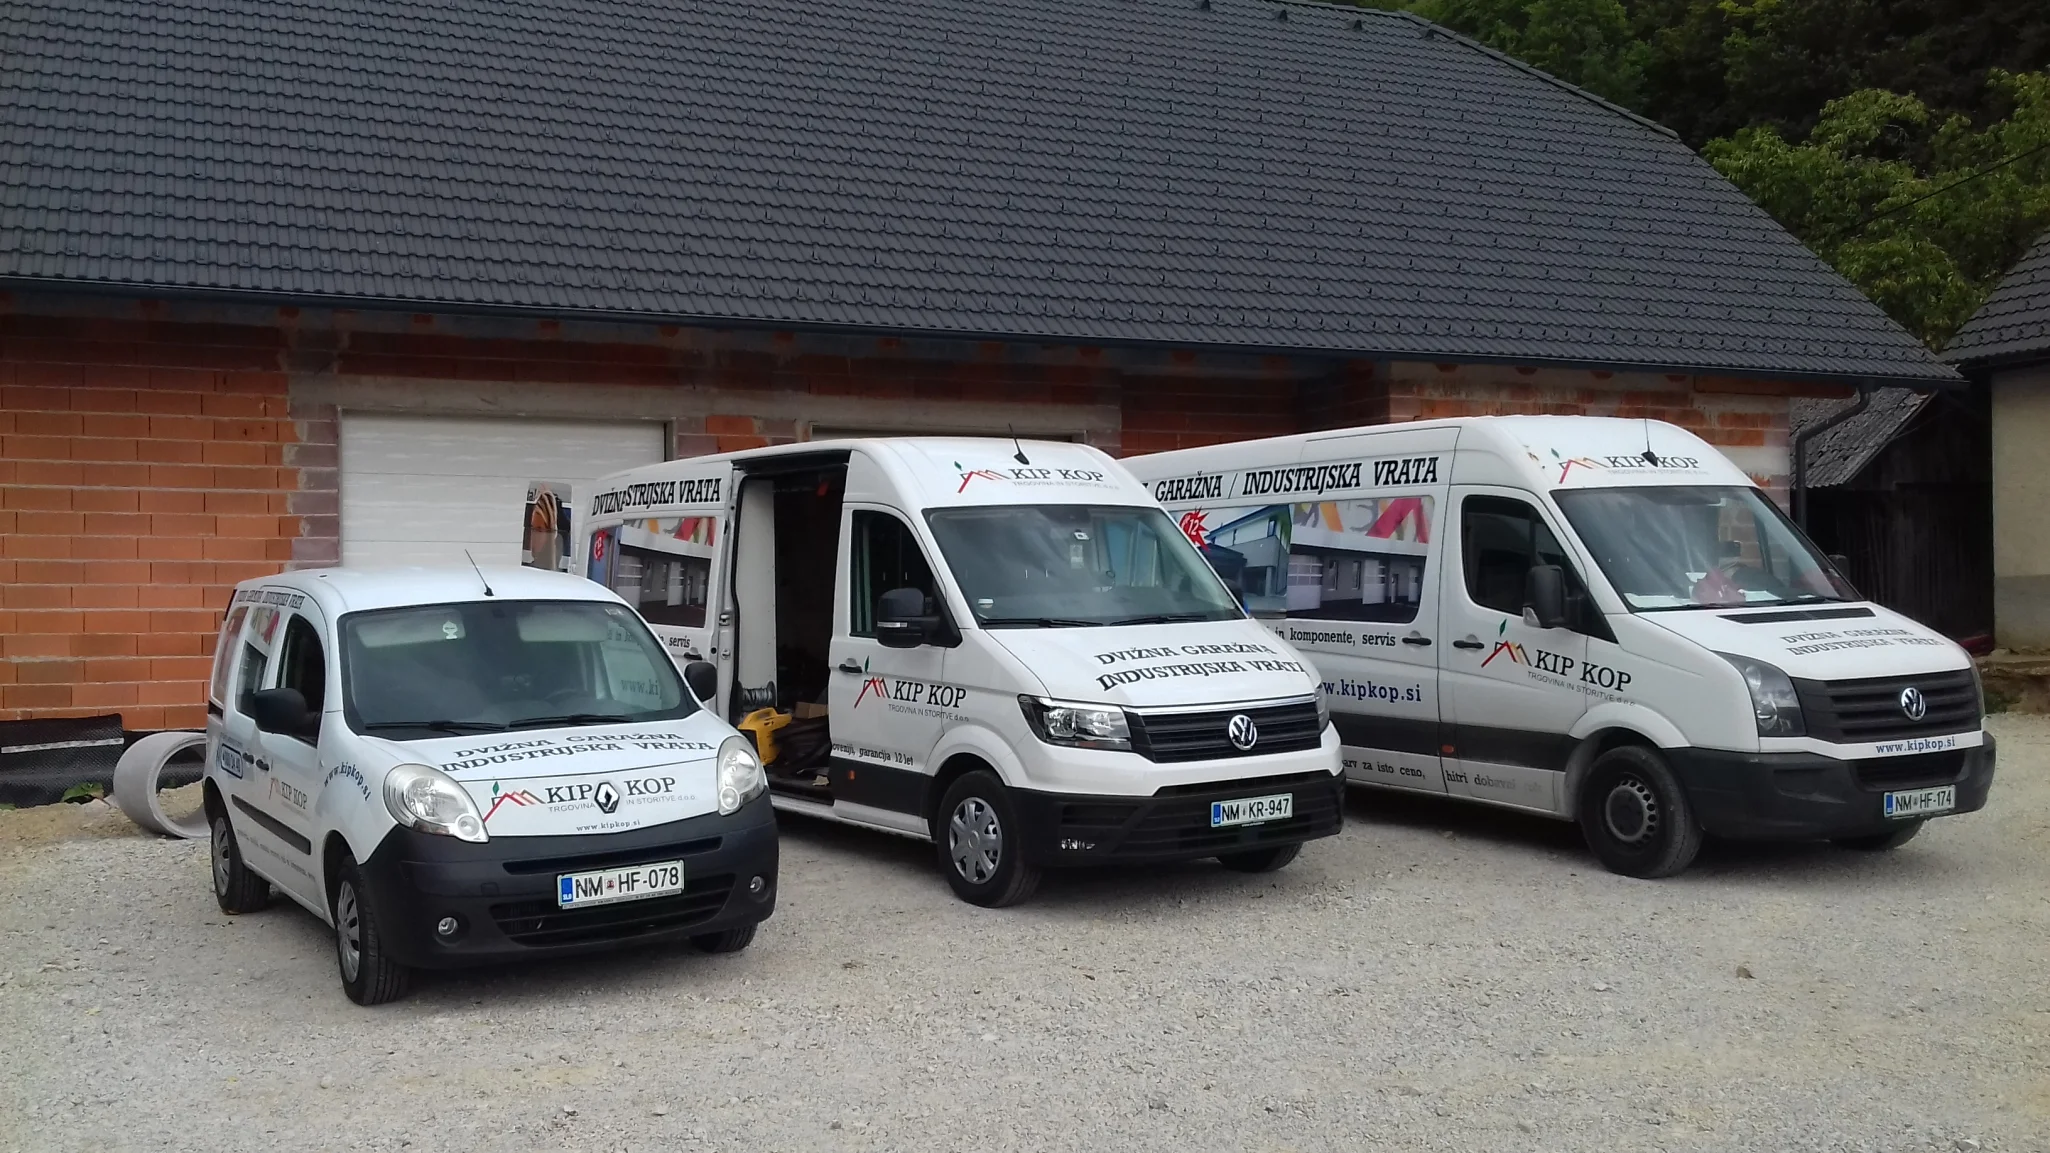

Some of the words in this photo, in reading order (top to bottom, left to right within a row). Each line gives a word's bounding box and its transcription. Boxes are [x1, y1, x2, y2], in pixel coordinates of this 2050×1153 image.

[1604, 456, 1646, 467] KIP
[1656, 457, 1699, 468] KOP
[1008, 468, 1051, 480] KIP
[1055, 469, 1104, 482] KOP
[1155, 471, 1223, 502] GARAŽNA
[1228, 473, 1238, 499] /
[1242, 463, 1362, 495] INDUSTRIJSKA
[1373, 457, 1439, 486] VRATA
[679, 478, 722, 503] VRATA
[1187, 518, 1200, 536] 12
[668, 635, 691, 648] servis
[1290, 627, 1356, 646] komponente,
[1362, 632, 1396, 646] servis
[1780, 631, 1840, 644] DVIŽNA
[1786, 637, 1893, 656] INDUSTRIJSKA
[1094, 647, 1180, 665] DVIŽNA
[1181, 642, 1278, 656] GARAŽNA
[1096, 661, 1248, 691] INDUSTRIJSKA
[1534, 649, 1575, 677] KIP
[1580, 661, 1632, 692] KOP
[893, 680, 924, 702] KIP
[926, 684, 967, 708] KOP
[1527, 671, 1565, 687] TRGOVINA
[1566, 682, 1575, 690] IN
[1576, 685, 1615, 702] STORITVE
[453, 739, 556, 757] DVIŽNA
[566, 733, 684, 742] GARAŽNA
[858, 747, 892, 762] garancija
[1876, 736, 1956, 753] www.kipkop.si
[440, 743, 625, 771] INDUSTRIJSKA
[632, 742, 716, 750] VRATA
[323, 761, 372, 802] www.kipkop.si
[1363, 762, 1373, 771] za
[1377, 762, 1395, 774] isto
[1400, 767, 1426, 780] ceno,
[1446, 770, 1469, 784] hitri
[281, 781, 294, 804] KIP
[293, 787, 308, 810] KOP
[545, 784, 593, 805] KIP
[624, 777, 676, 796] KOP
[1895, 795, 1912, 812] NM
[1919, 790, 1952, 809] HF-174
[548, 803, 597, 813] TRGOVINA
[637, 795, 676, 804] STORITVE
[1222, 803, 1240, 821] NM
[1248, 798, 1289, 818] KR-947
[576, 819, 640, 832] www.kipkop.si
[575, 876, 604, 898] NM
[618, 866, 679, 893] HF-078
